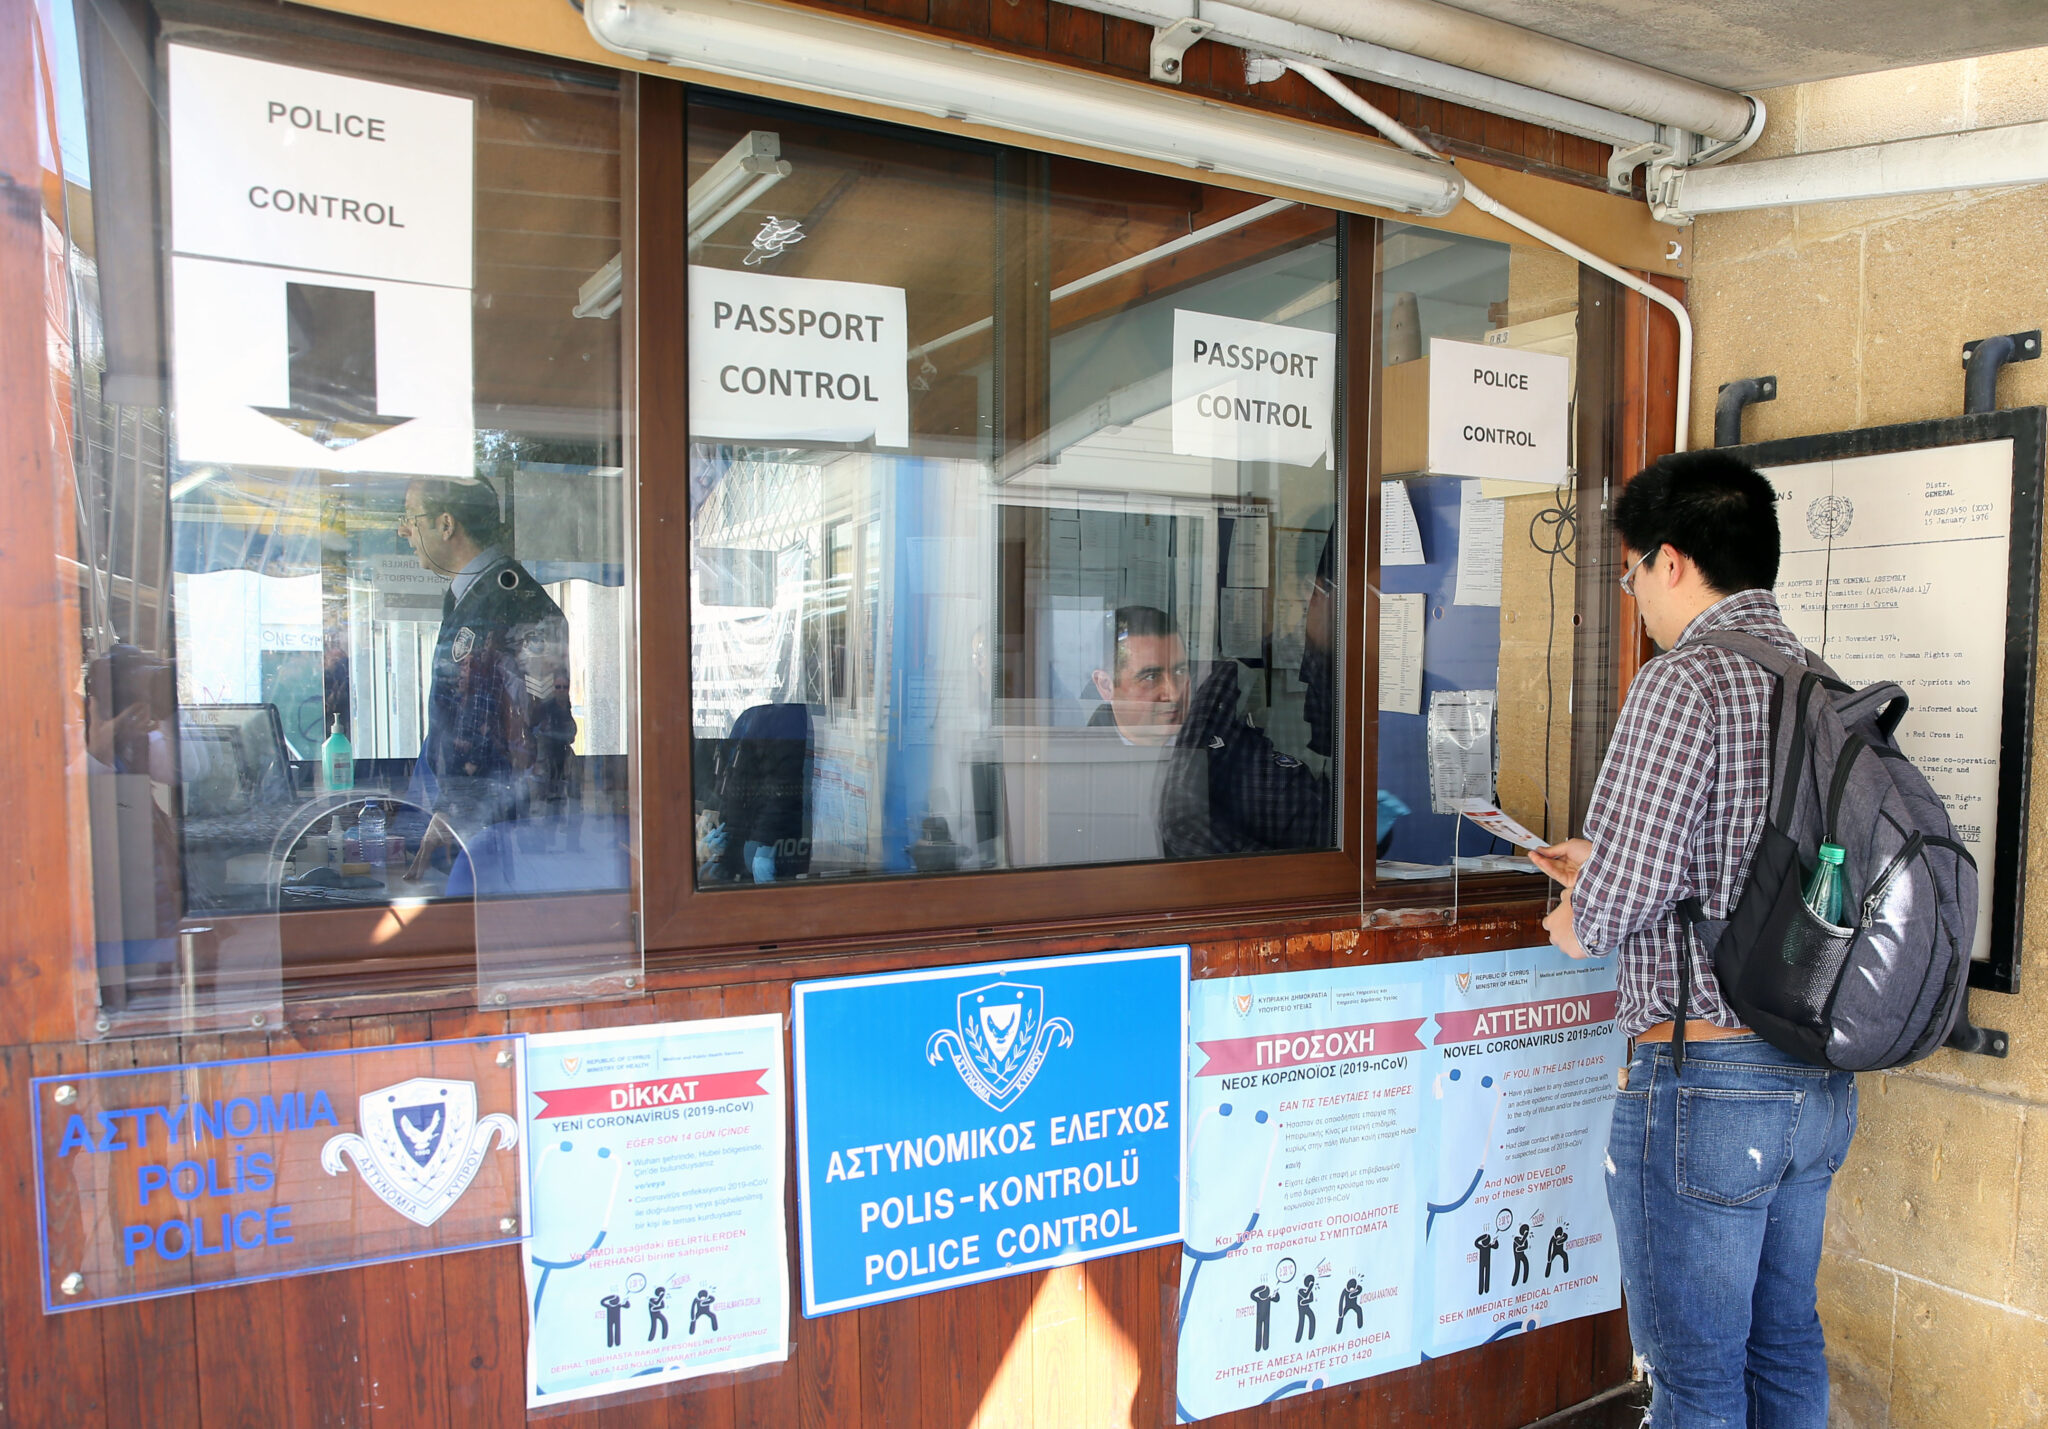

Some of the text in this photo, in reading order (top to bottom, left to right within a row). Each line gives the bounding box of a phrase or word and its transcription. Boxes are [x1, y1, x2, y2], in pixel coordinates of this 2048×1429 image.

[268, 101, 385, 141] POLICE
[249, 186, 406, 228] CONTROL
[714, 302, 883, 342] PASSPORT
[1194, 340, 1318, 378] PASSPORT
[720, 365, 878, 401] CONTROL
[1474, 369, 1528, 390] POLICE
[1197, 394, 1312, 429] CONTROL
[1463, 426, 1536, 447] CONTROL
[1925, 490, 1955, 498] GENERAL
[1925, 503, 1993, 516] A/RES/3450 (XXX)
[1924, 651, 1950, 660] Rights
[1919, 679, 1953, 687] Cypriots
[1944, 757, 1996, 765] co-operation
[1956, 794, 1981, 802] Rights
[1476, 973, 1500, 981] REPUBLIC
[1509, 969, 1529, 977] CYPRUS
[1476, 982, 1499, 990] MINISTRY
[1508, 978, 1527, 986] HEALTH
[1259, 995, 1289, 1003] ΚΥΠΡΙΑΚΗ
[1291, 991, 1327, 1001] ΔΗΜΟΚΡΑΤΙΑ
[1259, 1002, 1312, 1013] ΥΠΟΥΡΓΕΙΟ ΥΓΕΙΑΣ
[1473, 1000, 1590, 1036] ATTENTION
[1256, 1029, 1375, 1066] ΠΡΟΣΟΧΗ
[1444, 1024, 1614, 1059] NOVEL CORONAVIRUS 2019-nCoV
[954, 1049, 1043, 1101] ΑΣΤΥΝΟΜΙΑ ΚΥΠΡΟΥ
[1222, 1057, 1407, 1091] ΝΕΟΣ ΚΟΡΩΝΟΪΟΣ (2019-nCoV)
[1504, 1056, 1606, 1080] IF YOU, IN THE LAST 14 DAYS:
[610, 1081, 699, 1110] DİKKAT
[1280, 1085, 1414, 1112] ΕΑΝ ΤΙΣ ΤΕΛΕΥΤΑΙΕΣ 14 ΜΕΡΕΣ:
[58, 1090, 339, 1157] ΑΣΤΥΝΟΜΙΑ
[553, 1102, 754, 1132] YENİ CORONAVİRÜS (2019-nCoV)
[1507, 1125, 1525, 1134] and/or
[826, 1101, 1169, 1184] ΑΣΤΥΝΟΜΙΚΟΣ ΕΛΕΓΧΟΣ
[138, 1144, 275, 1206] POLİS
[360, 1149, 480, 1215] ΑΣΤΥΝΟΜΙΑ ΚΥΠΡΟΥ
[1475, 1175, 1573, 1205] any of these SYMPTOMS
[1484, 1164, 1566, 1189] And NOW DEVELOP
[123, 1205, 294, 1266] POLICE
[1216, 1204, 1399, 1246] Και ΤΩΡΑ εμφανίσατε ΟΠΟΙΟΔΗΠΟΤΕ
[1226, 1248, 1248, 1258] από
[1266, 1234, 1317, 1252] παρακάτω
[1320, 1220, 1388, 1241] ΣΥΜΠΤΩΜΑΤΑ
[865, 1207, 1138, 1285] POLICE CONTROL
[1467, 1252, 1478, 1264] FEVER
[1440, 1275, 1598, 1325] SEEK IMMEDIATE MEDICAL ATTENTION
[1493, 1300, 1548, 1323] OR RING 1420
[1216, 1331, 1391, 1381] ΖΗΤΗΣΤΕ ΑΜΕΣΑ ΙΑΤΡΙΚΗ ΒΟΗΘΕΙΑ
[1238, 1349, 1372, 1389] Η ΤΗΛΕΦΩΝΗΣΤΕ ΣΤΟ 1420
